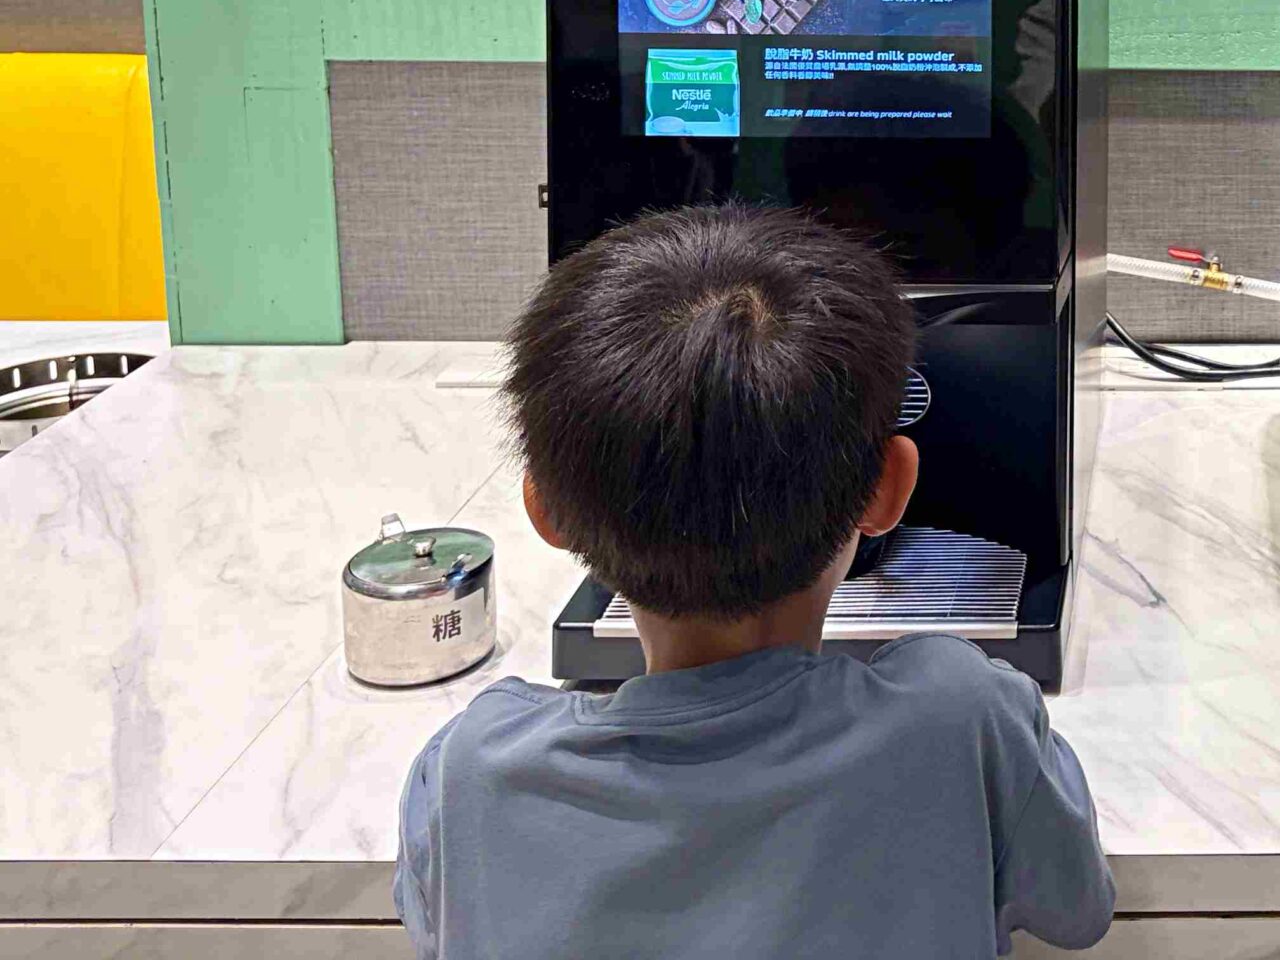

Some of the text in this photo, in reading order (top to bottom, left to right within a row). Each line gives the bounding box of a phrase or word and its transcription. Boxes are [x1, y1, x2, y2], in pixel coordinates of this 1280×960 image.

[816, 50, 874, 61] Skimmed
[877, 50, 905, 61] milk
[907, 51, 956, 63] powder
[675, 100, 710, 112] Alegria
[432, 609, 462, 643] 糖
